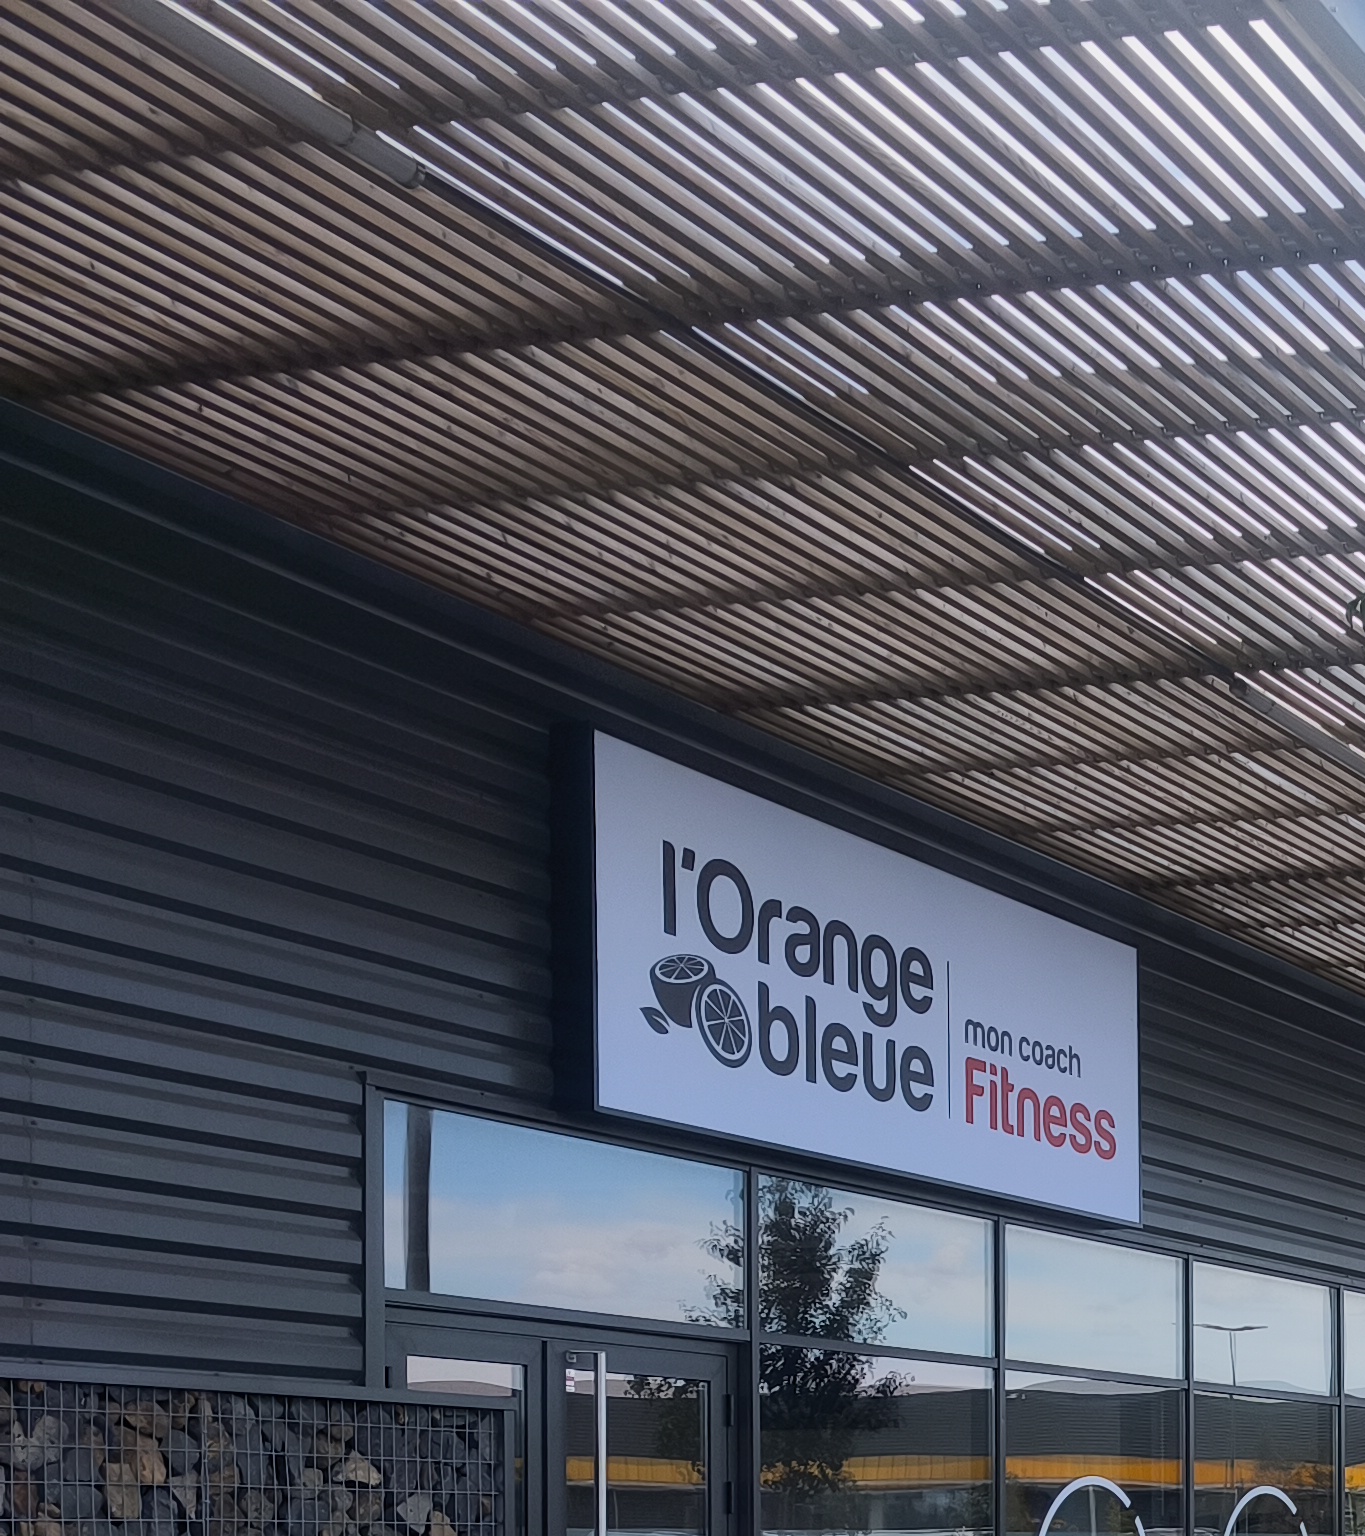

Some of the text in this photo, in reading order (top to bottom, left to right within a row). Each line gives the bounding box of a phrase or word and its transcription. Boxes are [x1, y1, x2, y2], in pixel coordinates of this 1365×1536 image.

[662, 839, 934, 1027] l'Orange
[758, 981, 934, 1111] bleue
[965, 1019, 1081, 1078] mon coach
[965, 1056, 1116, 1160] Fitness
